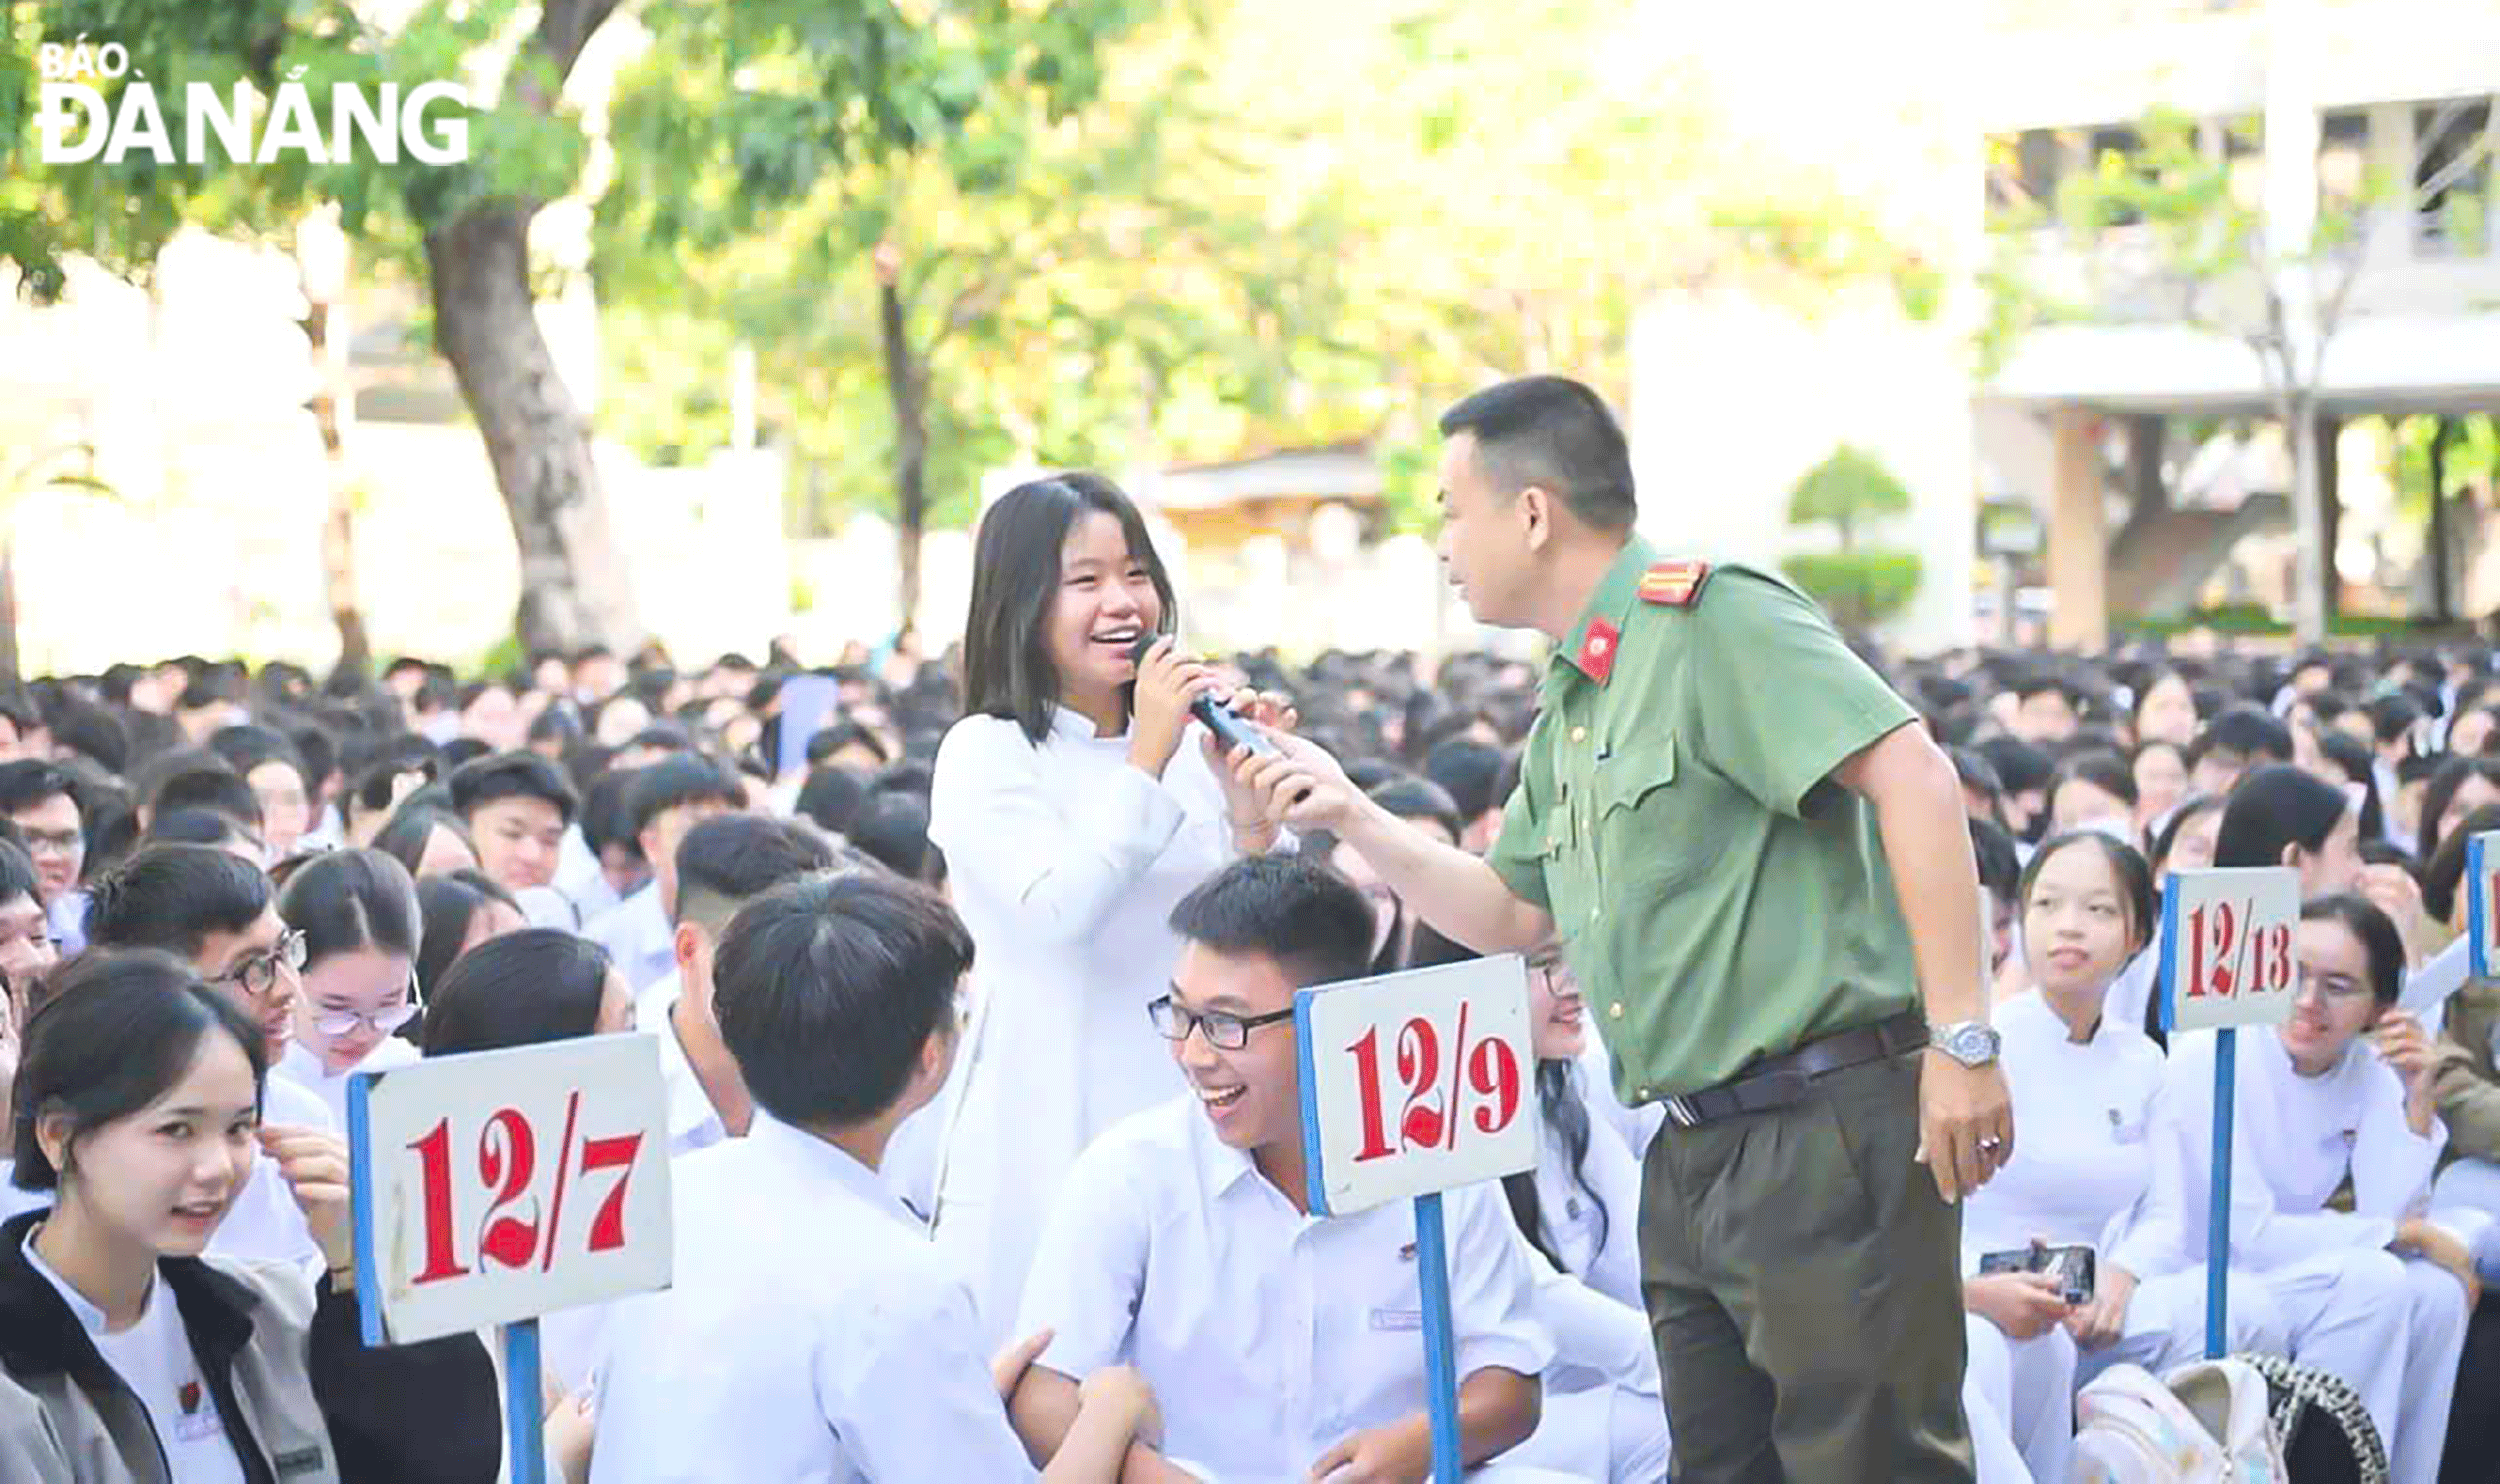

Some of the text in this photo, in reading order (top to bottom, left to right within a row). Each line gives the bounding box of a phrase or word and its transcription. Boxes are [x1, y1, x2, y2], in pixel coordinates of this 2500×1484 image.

[2187, 897, 2290, 998] 12/13
[1345, 1001, 1520, 1162] 12/9
[406, 1090, 645, 1284] 12/7
